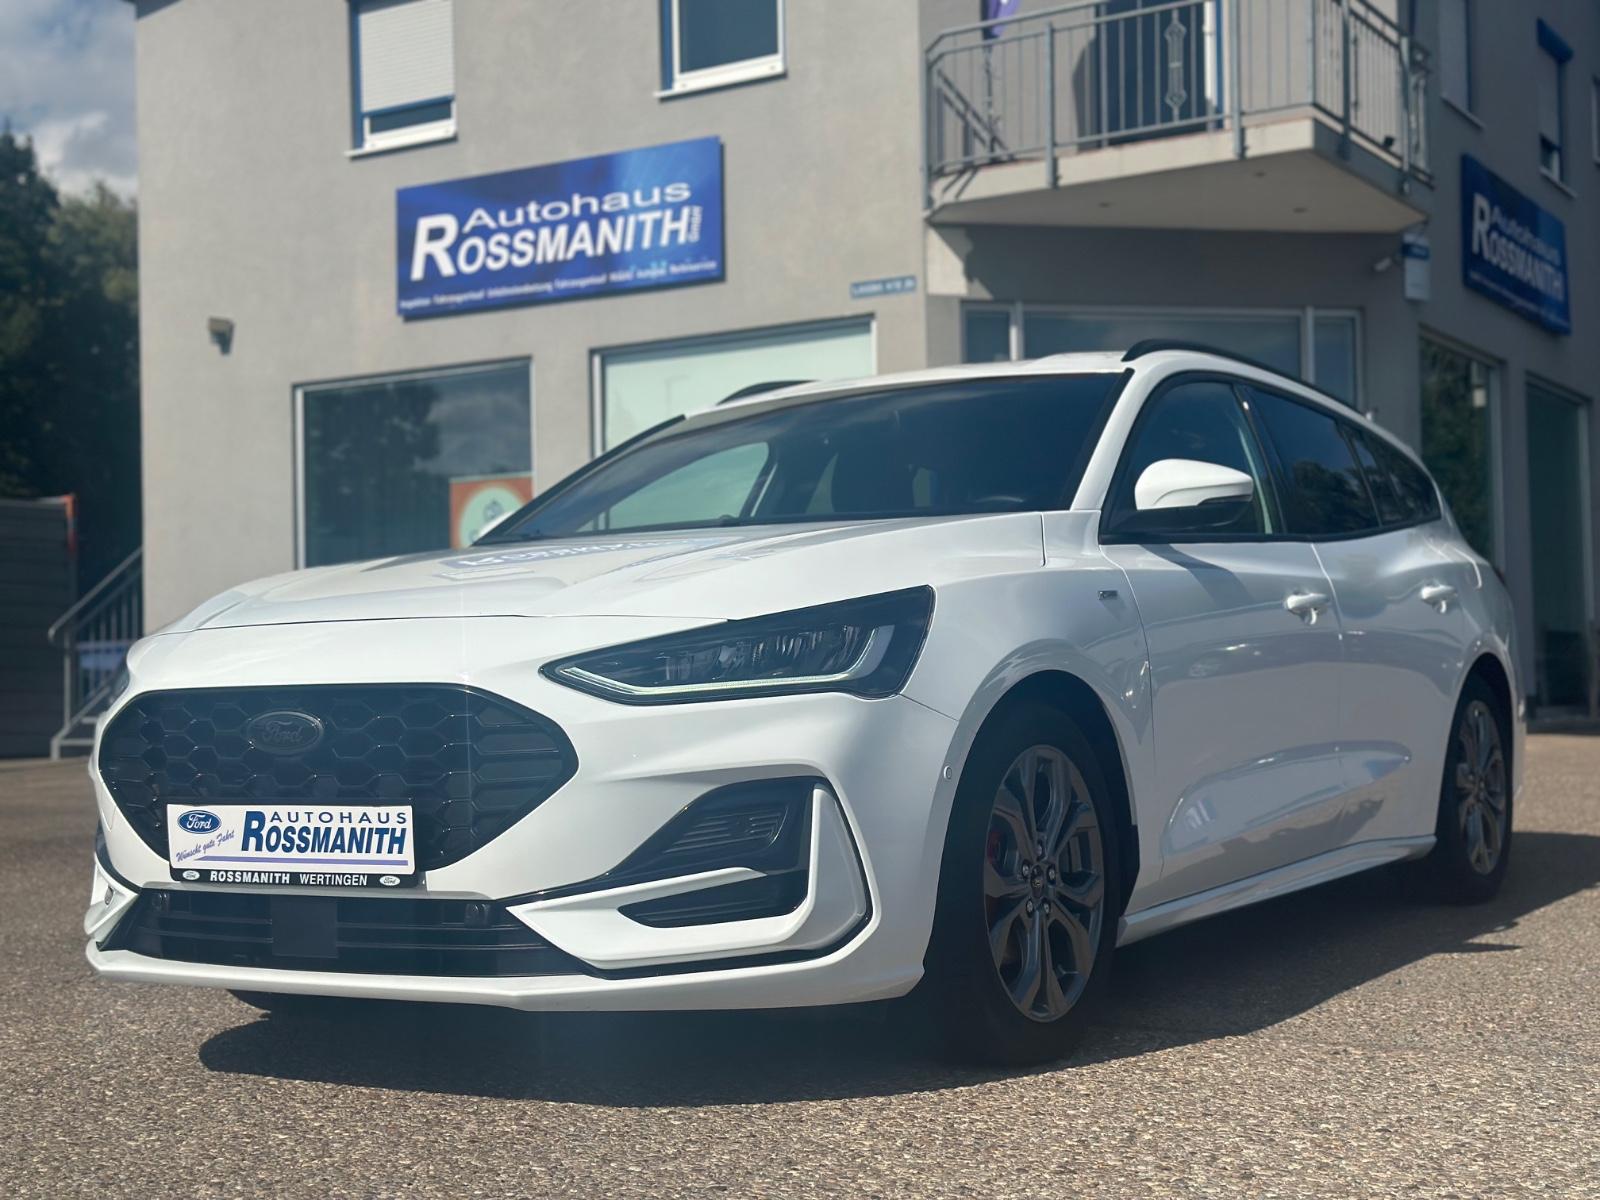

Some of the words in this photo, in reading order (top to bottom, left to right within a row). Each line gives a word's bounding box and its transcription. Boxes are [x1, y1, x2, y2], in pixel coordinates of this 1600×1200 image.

[462, 182, 691, 234] Autohaus
[410, 204, 690, 282] ROSSMANITH
[186, 813, 212, 829] Ford
[241, 810, 407, 855] ROSSMANITH
[270, 811, 407, 825] AUTOHAUS
[210, 870, 291, 885] ROSSMANITH
[299, 873, 368, 887] WERTINGEN
